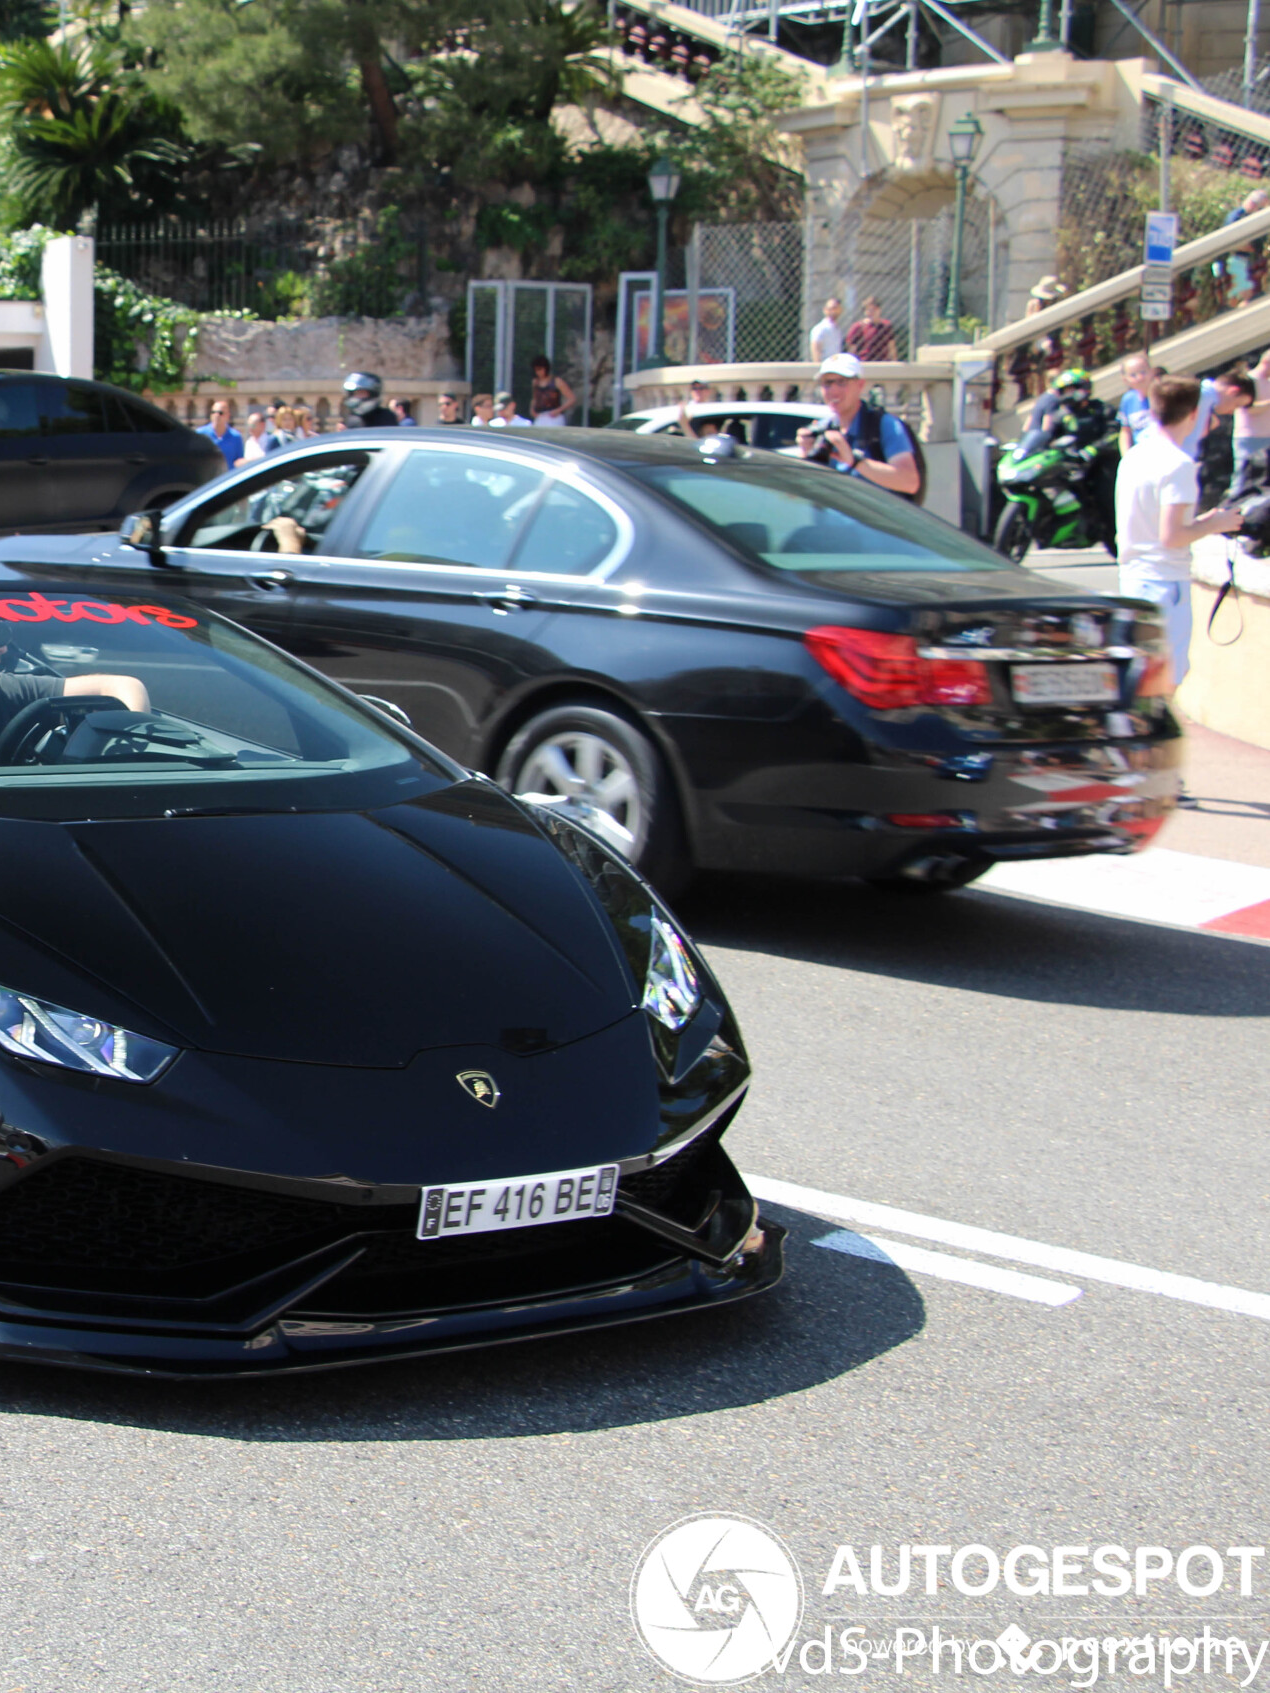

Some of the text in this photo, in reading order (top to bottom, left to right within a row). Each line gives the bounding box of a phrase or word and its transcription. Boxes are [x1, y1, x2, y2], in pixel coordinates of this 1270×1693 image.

[443, 1189, 486, 1228] EF
[493, 1182, 546, 1222] 416
[553, 1174, 595, 1215] BE
